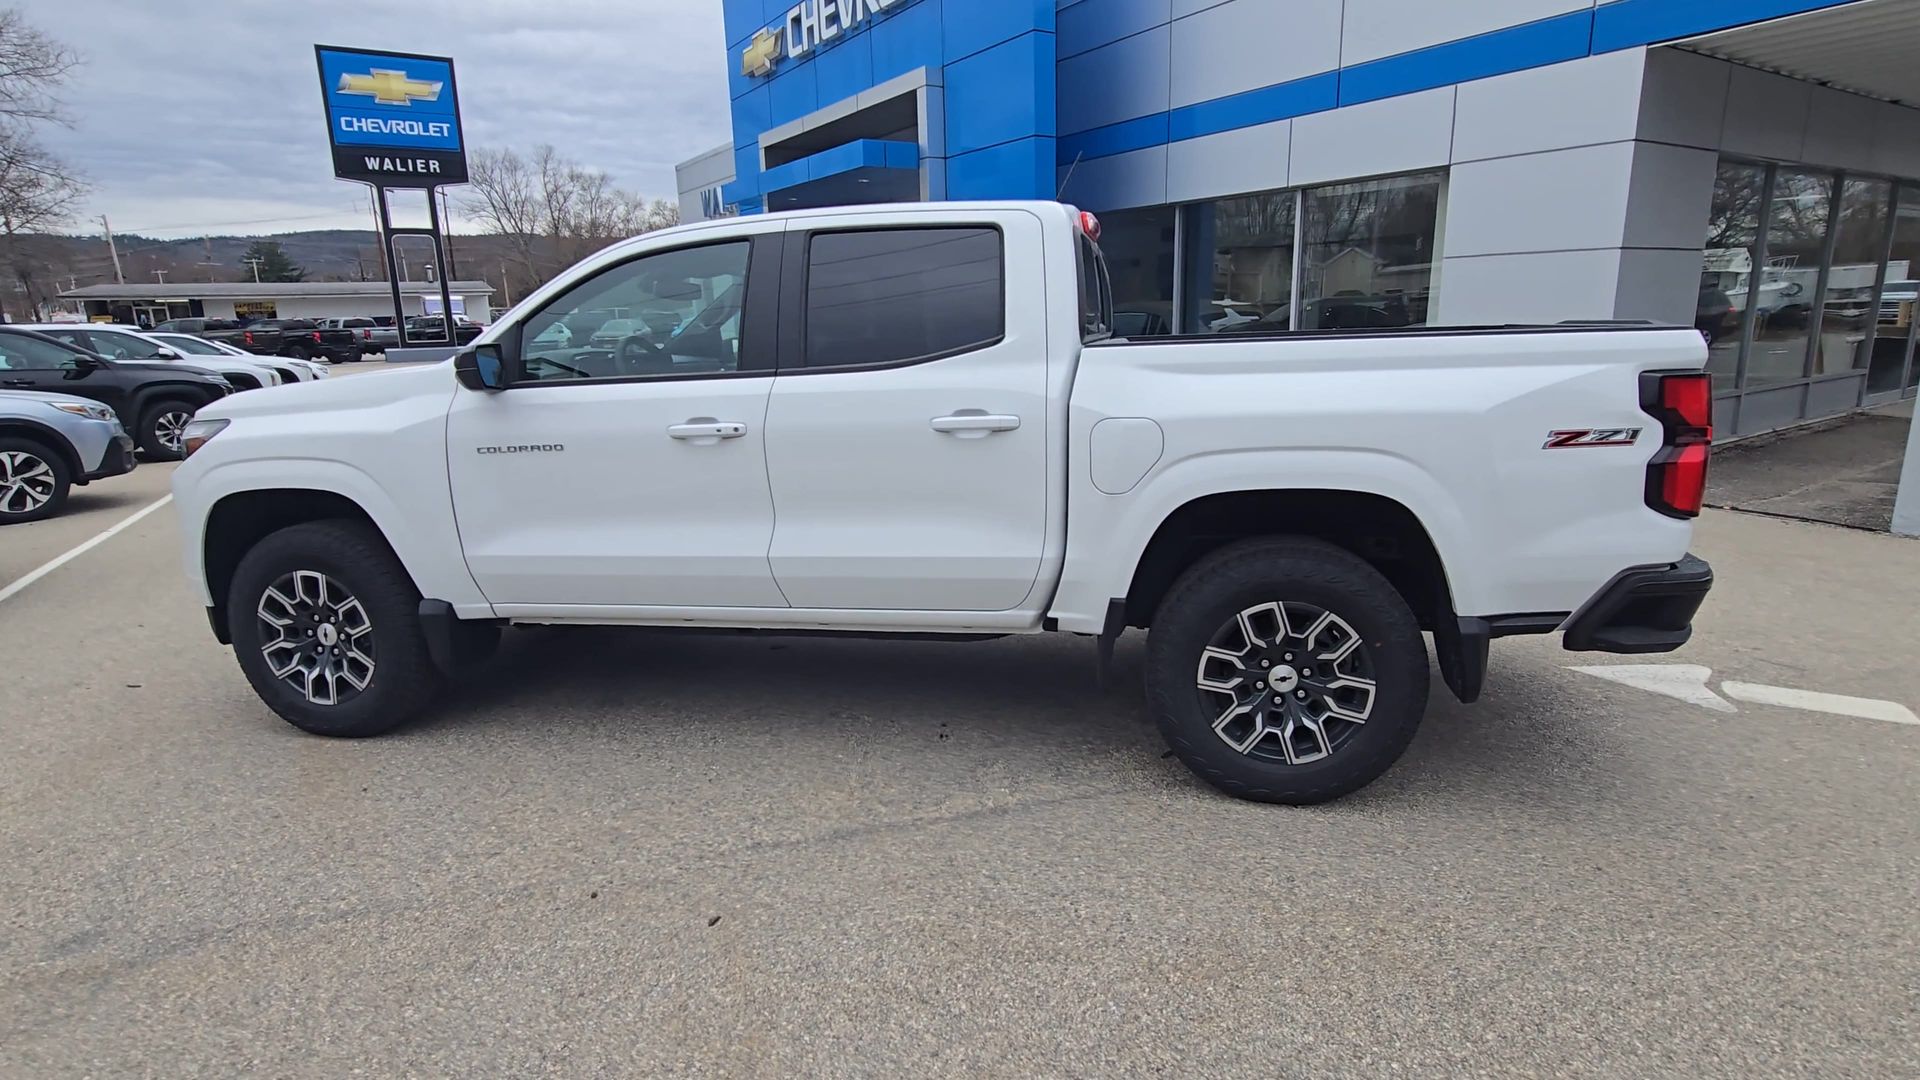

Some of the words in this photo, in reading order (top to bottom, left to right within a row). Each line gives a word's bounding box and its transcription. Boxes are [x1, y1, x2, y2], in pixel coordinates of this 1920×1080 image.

[340, 116, 450, 137] CHEVROLET
[365, 156, 441, 173] WALIER
[1542, 427, 1643, 449] Z71
[476, 444, 564, 454] COLORADO
